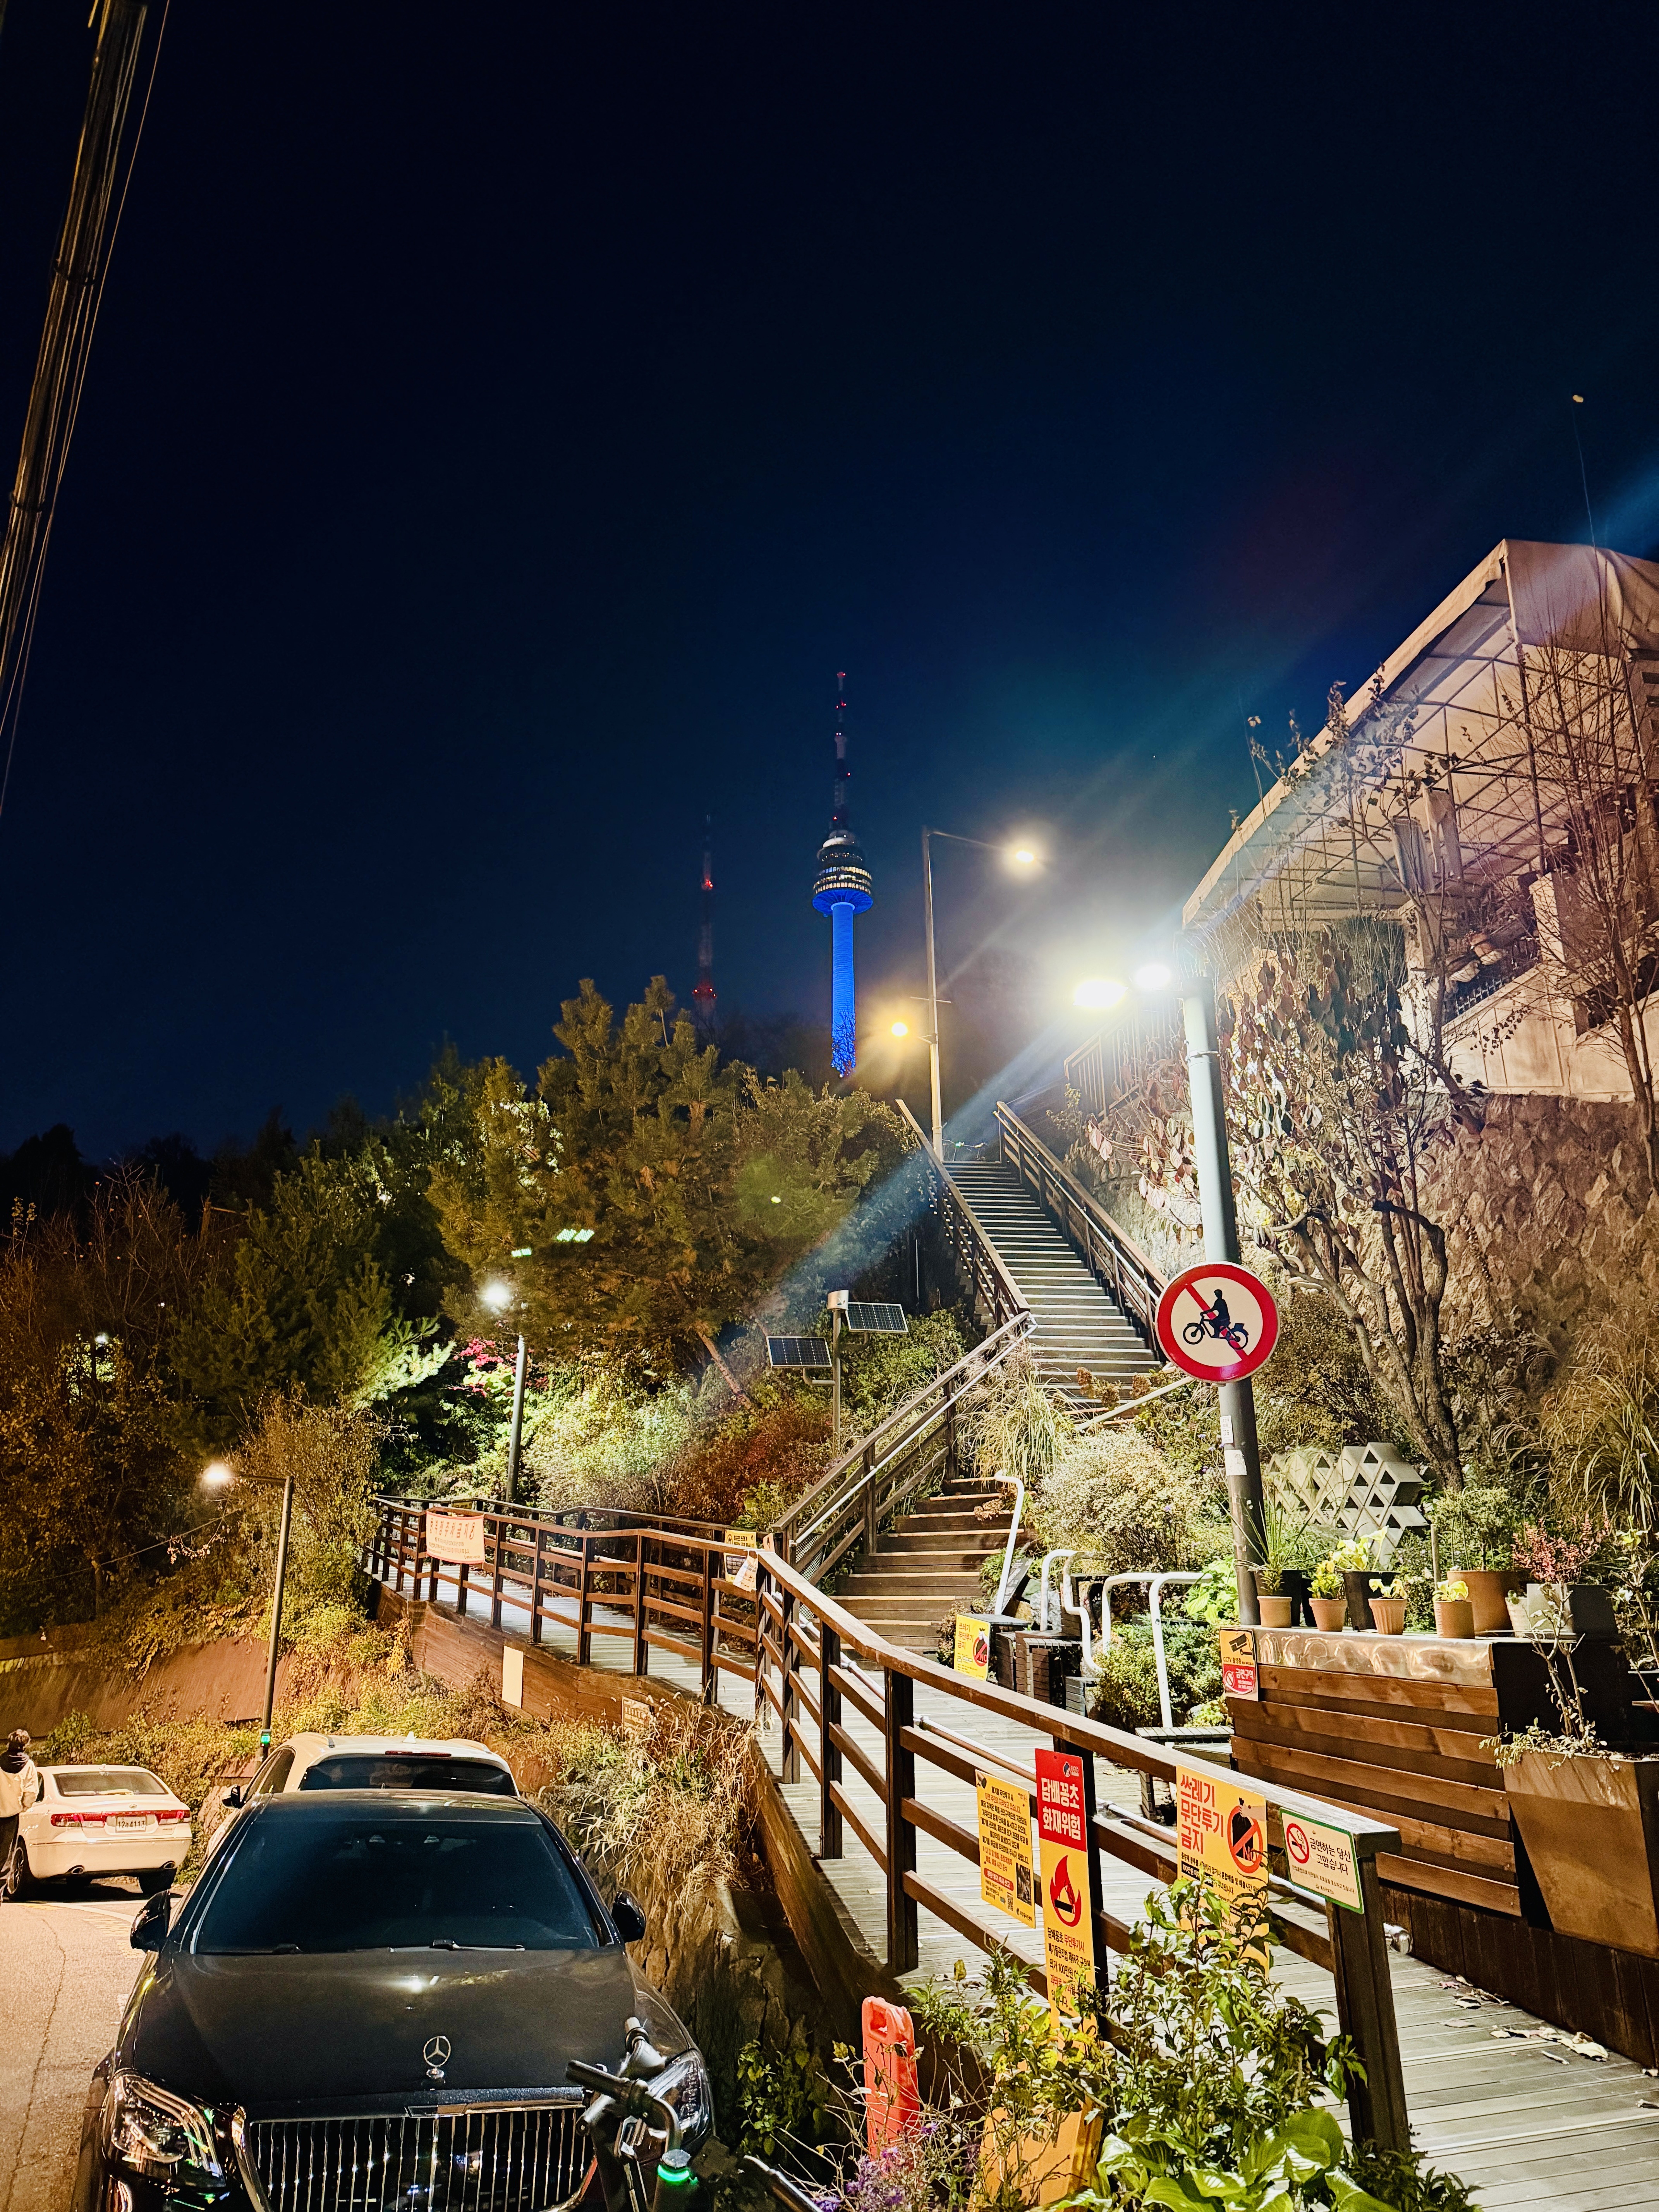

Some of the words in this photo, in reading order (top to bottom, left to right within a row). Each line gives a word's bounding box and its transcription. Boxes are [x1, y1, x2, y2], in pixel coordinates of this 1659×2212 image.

[958, 1631, 974, 1642] 무단투기
[959, 1623, 970, 1632] 쓰레기
[958, 1640, 966, 1649] 금지
[979, 1654, 987, 1662] NO
[1235, 1668, 1254, 1680] 금연구역
[1041, 1777, 1080, 1809] 담배꽁초
[1180, 1774, 1214, 1807] 쓰레기
[1042, 1806, 1081, 1840] 화재위험
[1181, 1798, 1224, 1837] 무단투기
[1181, 1824, 1203, 1855] 금지
[1310, 1838, 1335, 1857] 금연하는
[1337, 1847, 1351, 1863] 당신
[1316, 1854, 1348, 1875] 고맙습니다
[1048, 1927, 1063, 1943] 담배꽁초
[1049, 1958, 1057, 1972] 의거
[1058, 1963, 1073, 1979] 100만원
[1051, 1990, 1068, 2008] 있니다.
